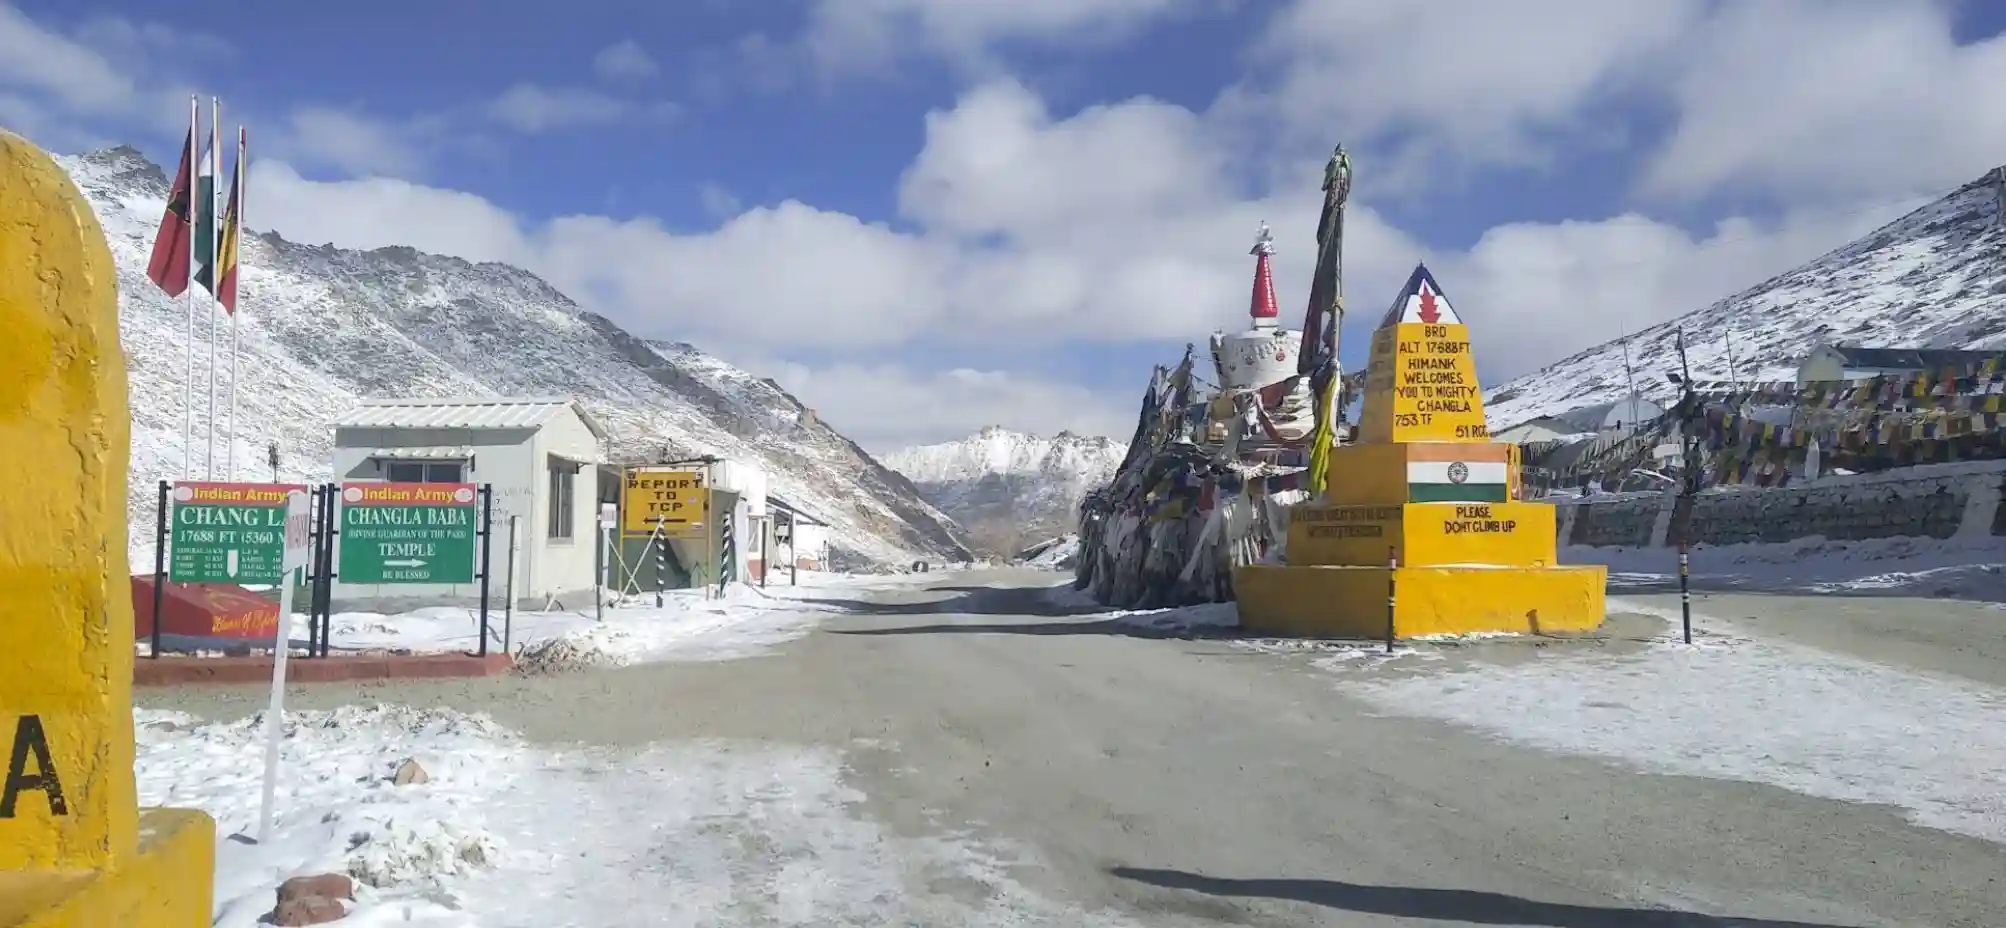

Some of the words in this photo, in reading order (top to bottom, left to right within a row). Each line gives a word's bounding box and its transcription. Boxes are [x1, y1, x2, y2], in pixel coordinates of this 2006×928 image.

[1425, 326, 1447, 338] BRO
[1400, 342, 1420, 353] ALT
[1408, 358, 1456, 369] HIMANK
[1404, 373, 1463, 384] WELCOMES
[1396, 386, 1417, 398] YOU
[1420, 386, 1433, 398] TO
[1436, 386, 1476, 398] MIGHTY
[1417, 401, 1472, 412] CHANGLA
[1396, 414, 1418, 426] 753
[628, 480, 704, 488] REPORT
[194, 488, 241, 500] Indian
[246, 488, 286, 503] Army
[364, 488, 410, 500] Indian
[415, 488, 454, 503] Army
[653, 492, 677, 500] TO
[648, 503, 683, 512] TCP
[1456, 507, 1491, 518] PLEASE
[181, 507, 260, 525] CHANG
[348, 508, 422, 525] CHANGLA
[428, 508, 467, 525] BABA
[1473, 521, 1500, 532] CLIMB
[1502, 521, 1516, 532] UP
[180, 530, 214, 543] 17688
[219, 531, 237, 543] FT
[378, 543, 436, 556] TEMPLE
[382, 571, 393, 579] BE
[395, 571, 430, 579] BLESSED
